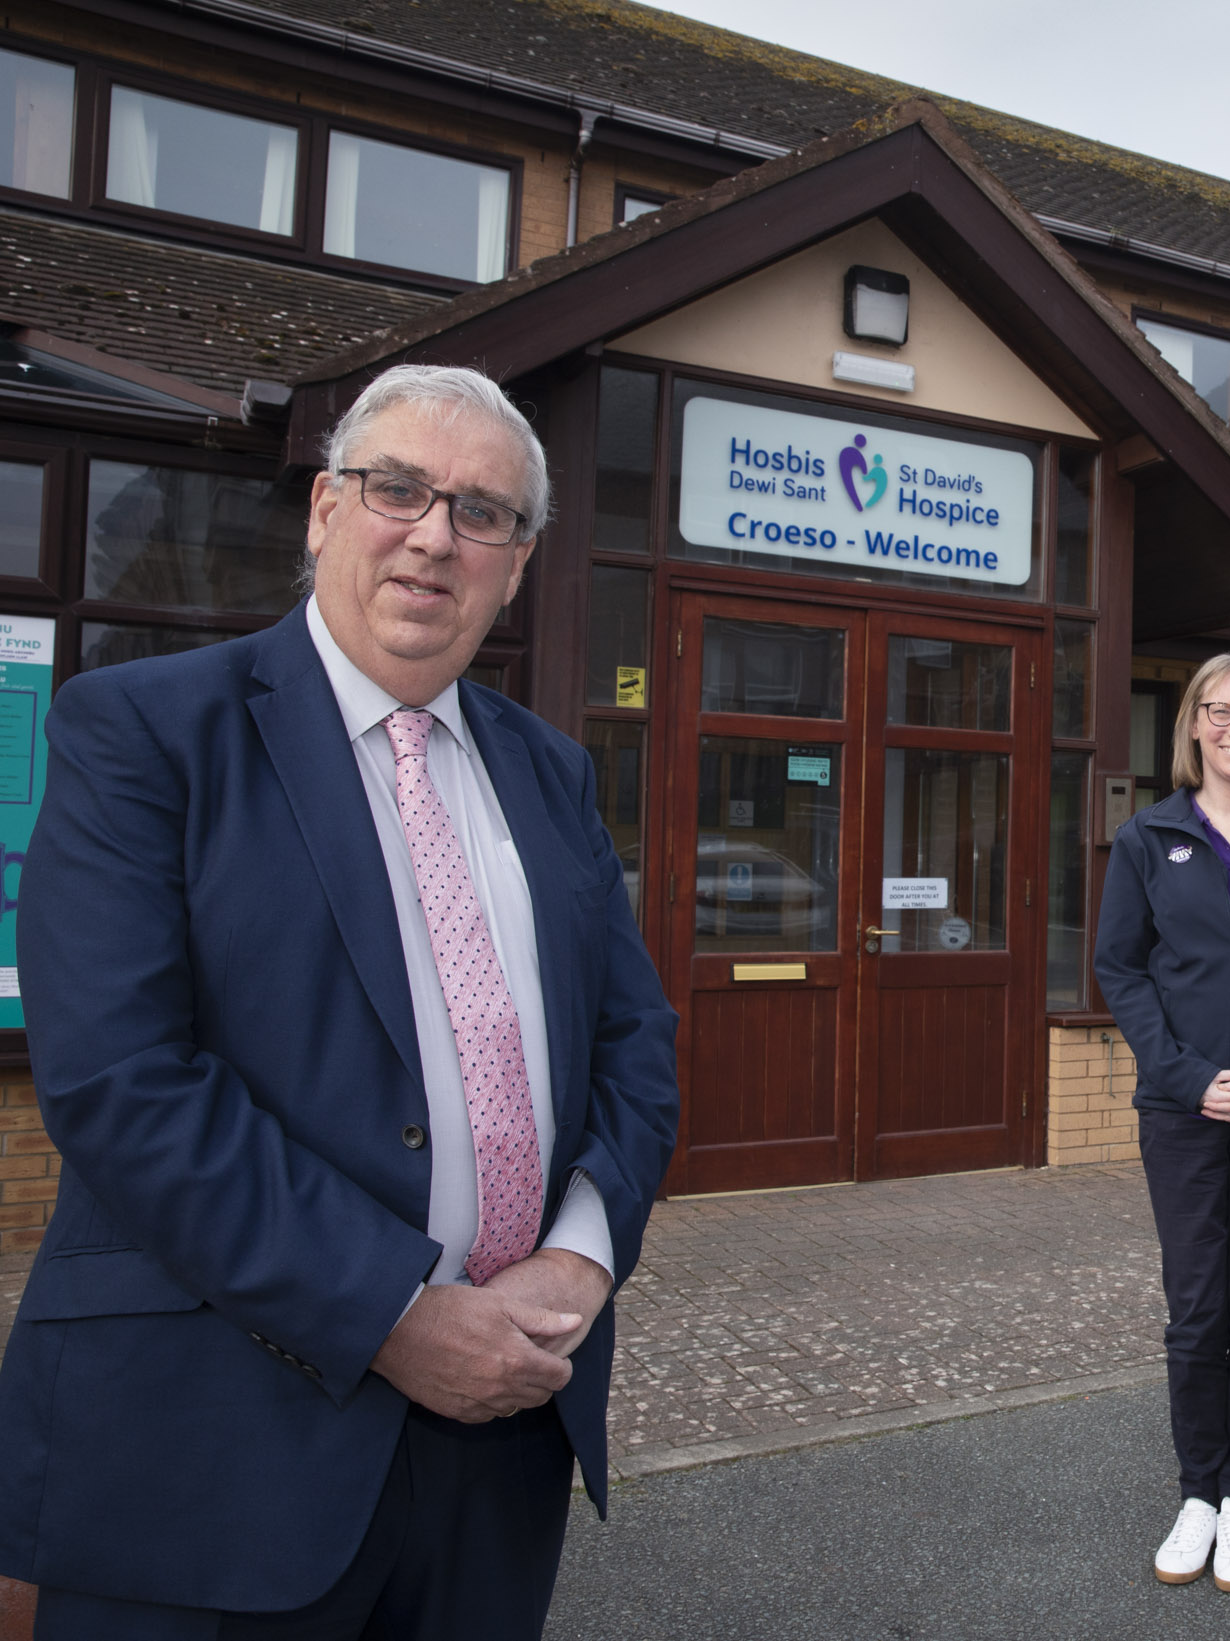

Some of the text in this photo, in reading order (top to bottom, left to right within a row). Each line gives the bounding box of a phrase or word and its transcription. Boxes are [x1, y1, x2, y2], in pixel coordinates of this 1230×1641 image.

[731, 437, 825, 477] Hosbis
[729, 469, 827, 503] Dewi Sant
[899, 463, 984, 494] St David's
[899, 487, 999, 527] Hospice
[728, 512, 837, 549] Croeso
[864, 529, 998, 570] Welcome
[6, 638, 41, 649] FYND
